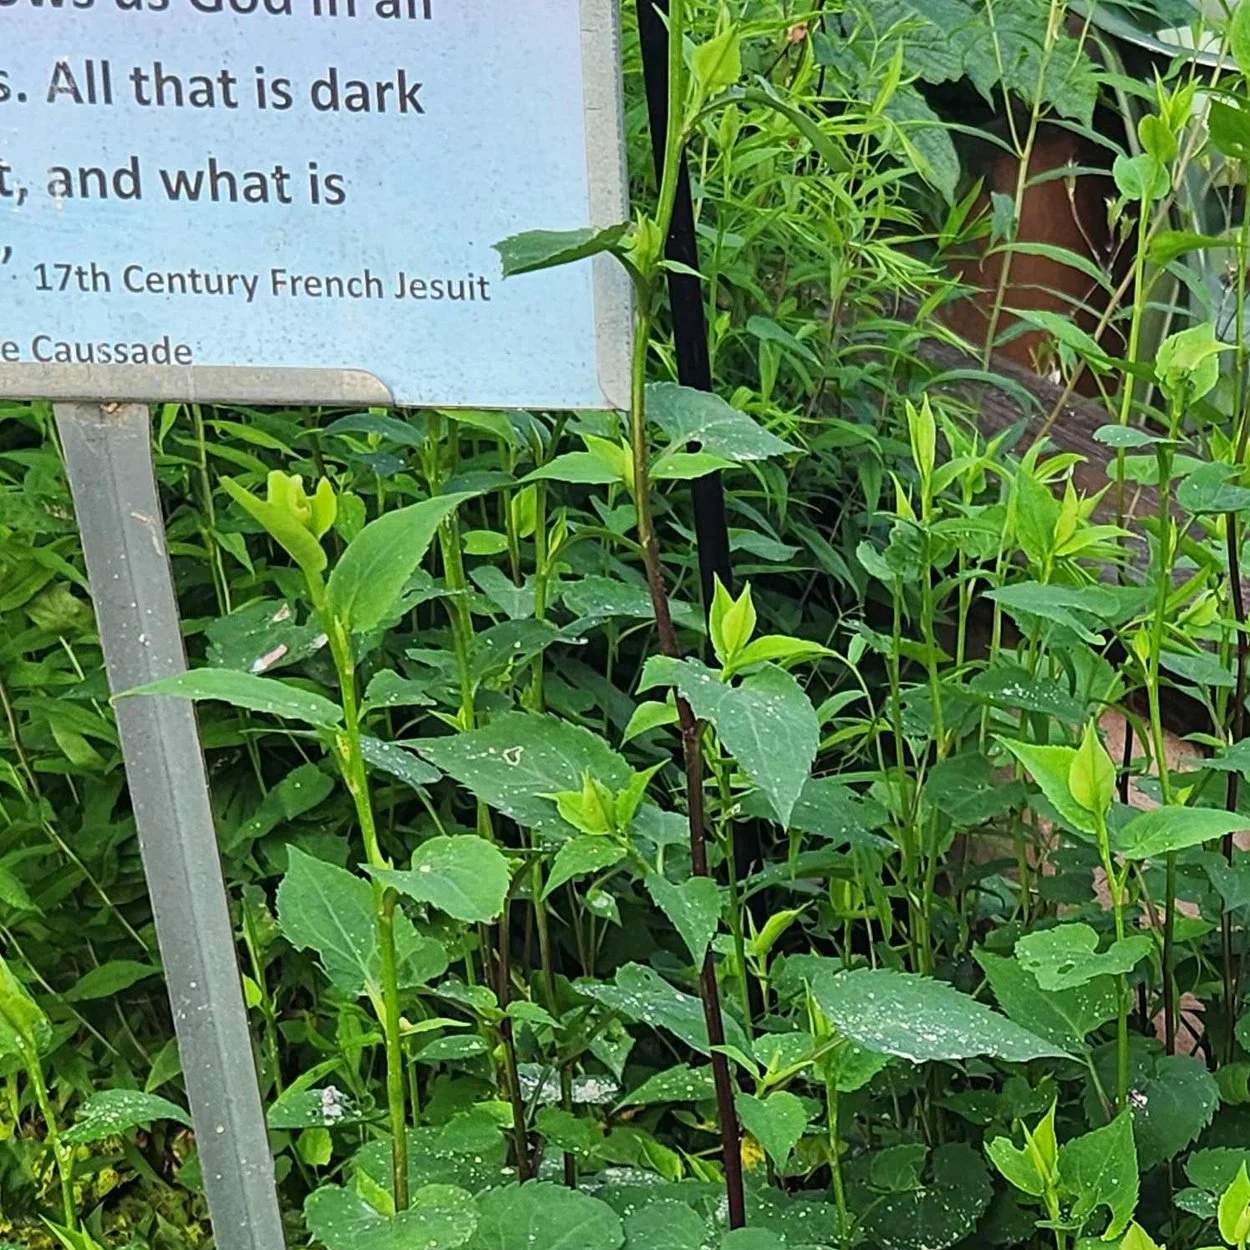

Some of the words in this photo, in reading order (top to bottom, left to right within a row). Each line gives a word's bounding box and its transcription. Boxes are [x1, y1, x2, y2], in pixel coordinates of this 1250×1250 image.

[47, 59, 112, 105] All
[129, 61, 239, 109] that
[255, 66, 293, 110] is
[311, 67, 425, 114] dark
[48, 155, 142, 200] and
[159, 157, 293, 205] what
[309, 161, 346, 206] is
[34, 262, 111, 293] 17th
[123, 265, 258, 303] Century
[271, 268, 383, 299] French
[395, 272, 491, 301] Jesuit
[32, 335, 192, 366] Caussade
